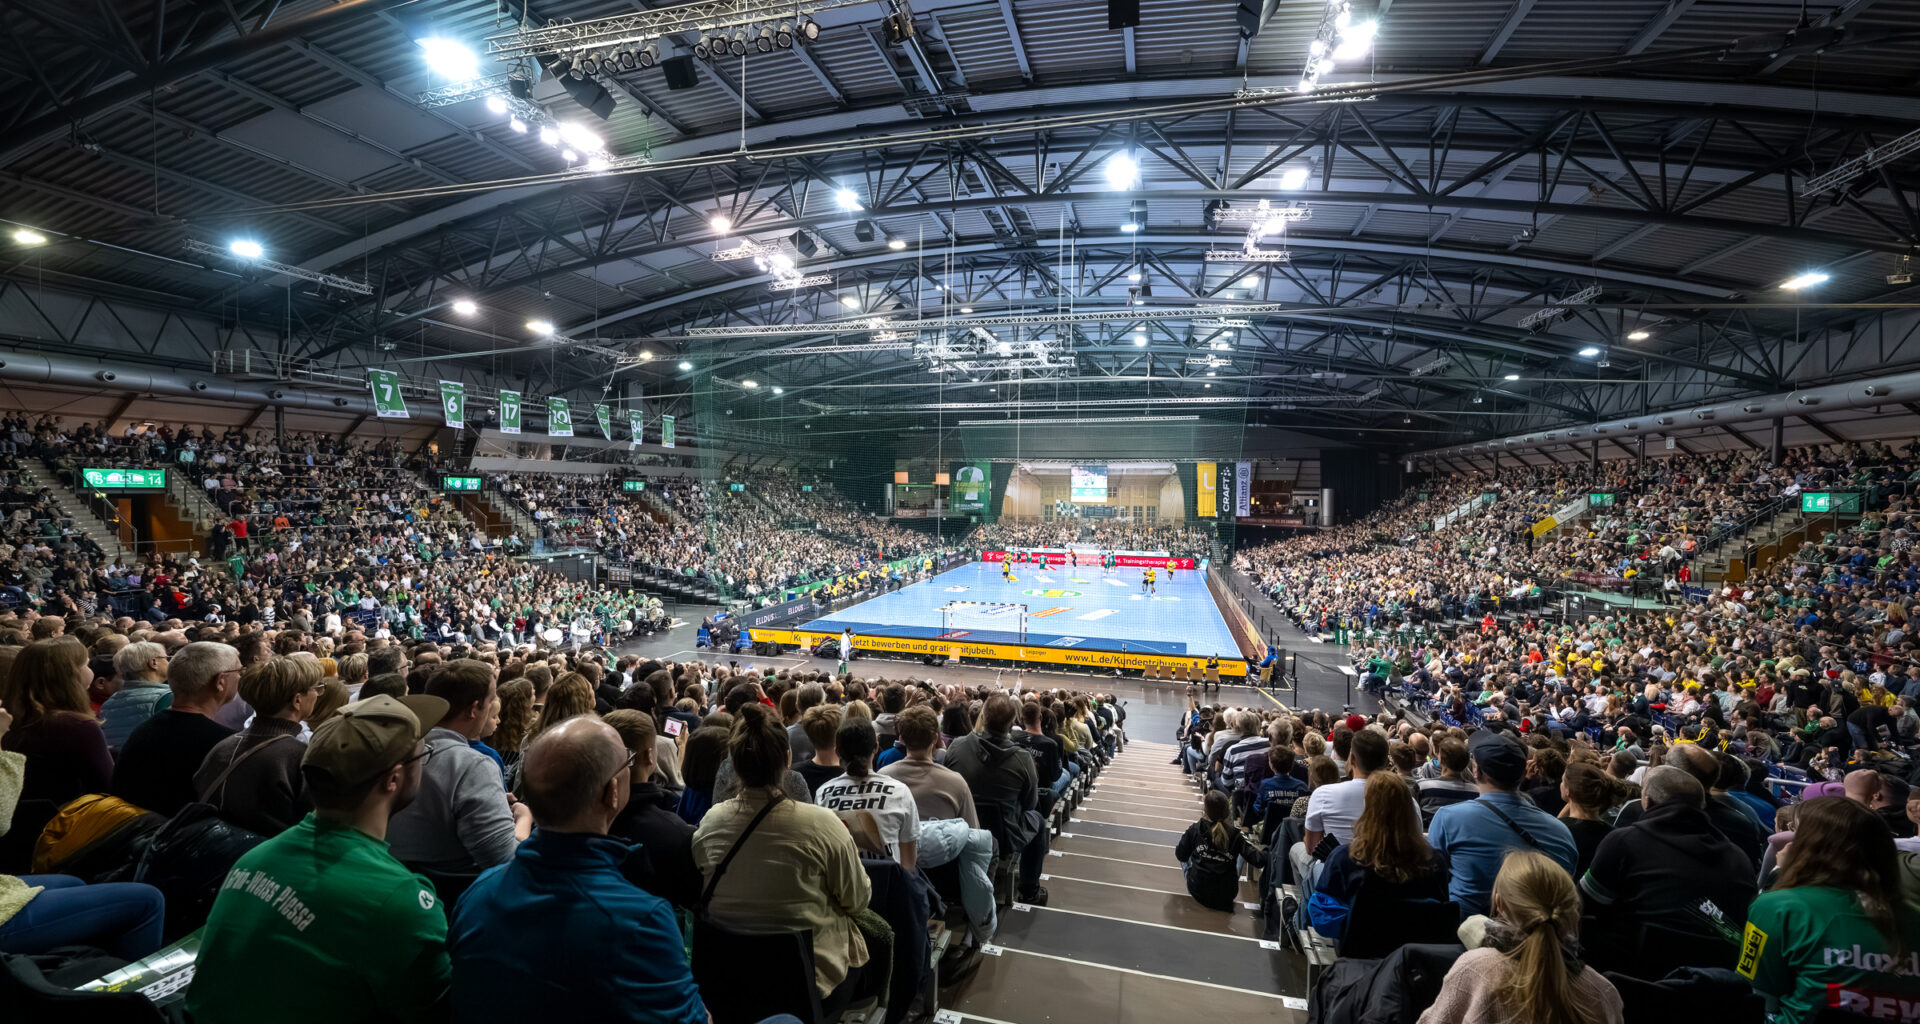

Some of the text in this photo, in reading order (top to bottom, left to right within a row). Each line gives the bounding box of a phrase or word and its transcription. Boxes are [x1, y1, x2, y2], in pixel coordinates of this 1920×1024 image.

[380, 384, 392, 401] 7
[447, 396, 458, 413] 6
[504, 403, 518, 420] 17
[552, 410, 568, 425] 10
[148, 476, 162, 485] 14
[1222, 477, 1230, 512] CRAFT
[1239, 480, 1247, 511] Allianz
[1806, 499, 1812, 509] 4
[755, 613, 774, 626] ELLDUS
[853, 639, 870, 647] jetzt
[872, 639, 911, 650] bewerben
[913, 642, 927, 651] und
[930, 644, 950, 653] grati
[820, 781, 895, 801] Pacific
[828, 796, 887, 811] Pearl
[272, 886, 315, 931] Plessa
